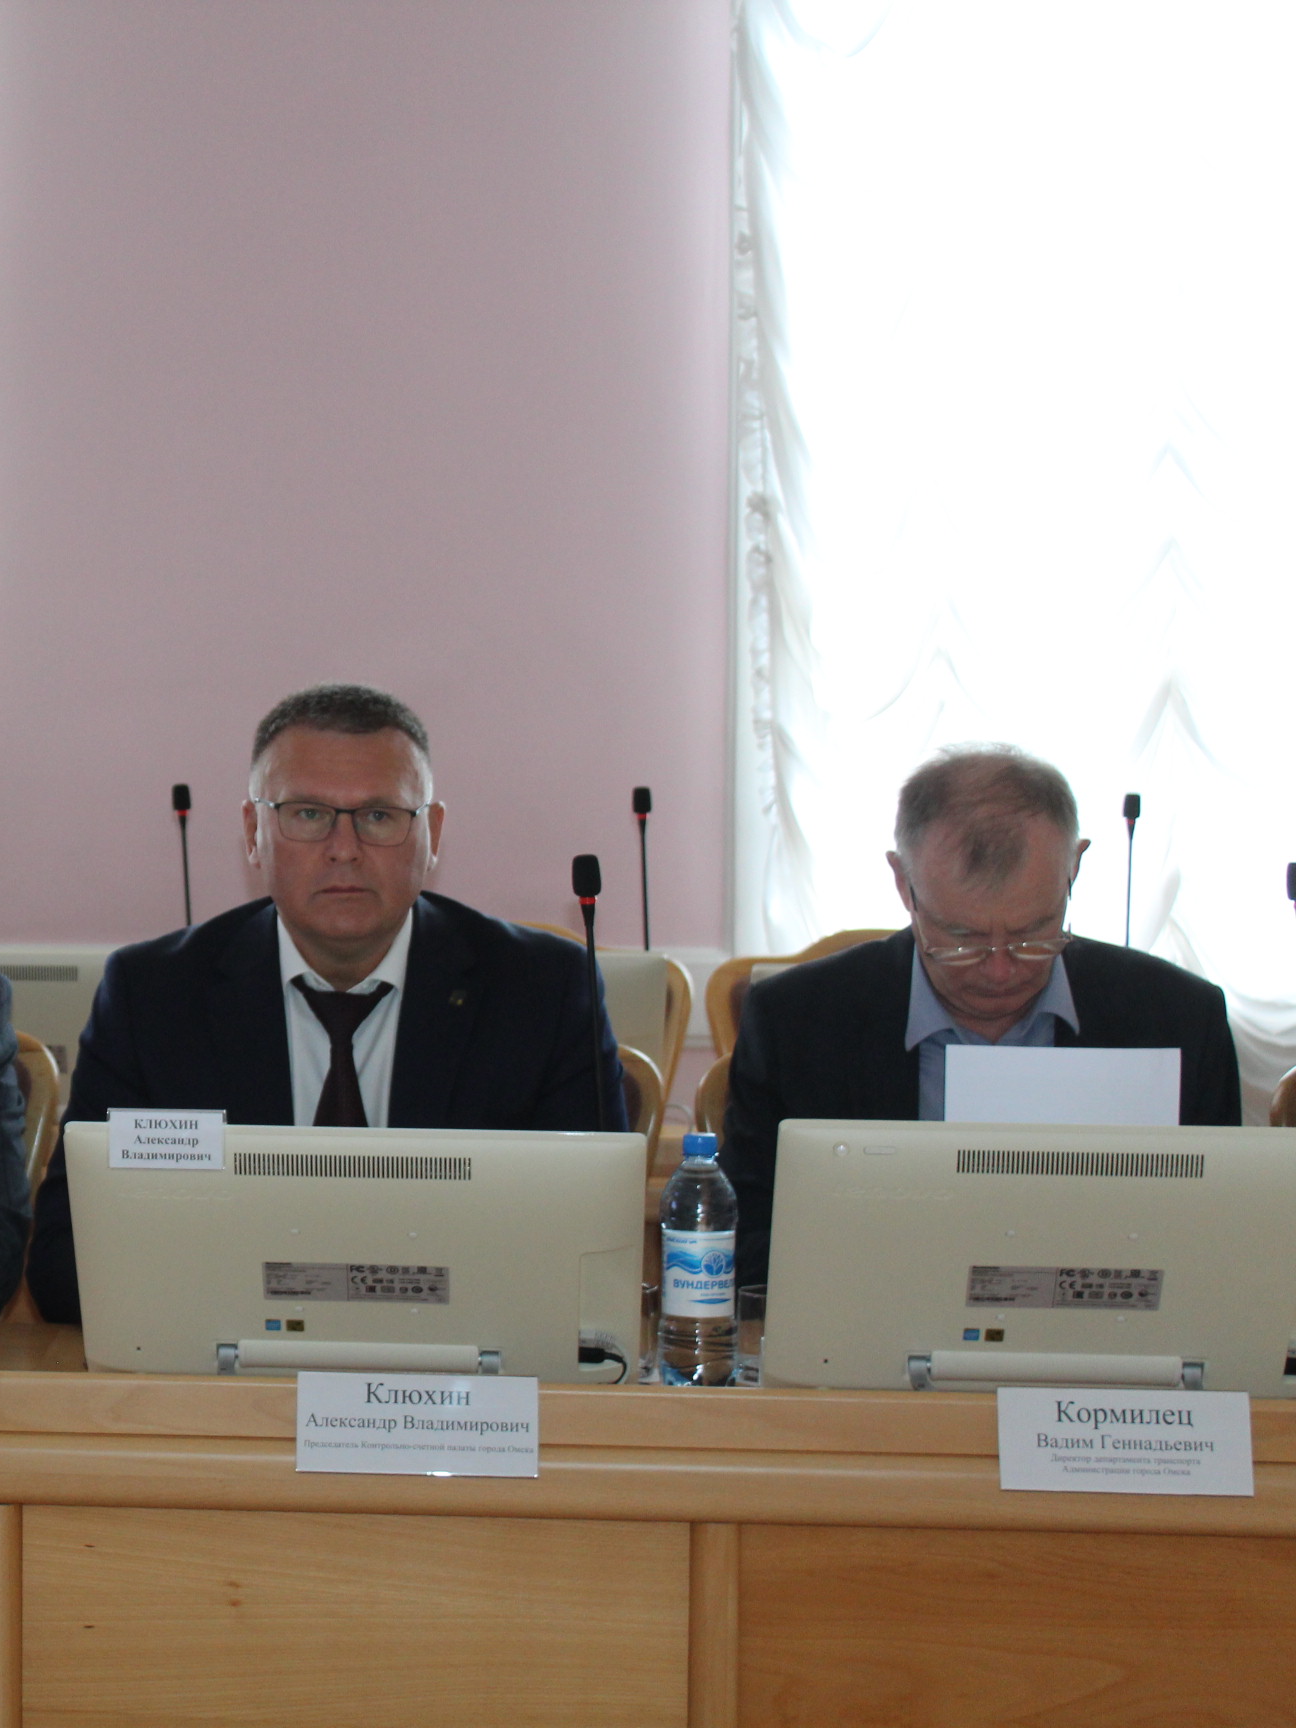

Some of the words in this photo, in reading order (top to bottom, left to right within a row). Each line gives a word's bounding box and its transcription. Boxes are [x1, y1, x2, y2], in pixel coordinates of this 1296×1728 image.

[134, 1119, 198, 1130] КЛЮХИН
[134, 1135, 199, 1148] Александр
[121, 1149, 212, 1162] Владимирович
[365, 1382, 471, 1406] Клюхин
[1055, 1401, 1194, 1429] Кормилец
[305, 1413, 397, 1433] Александр
[403, 1415, 531, 1435] Владимирович
[304, 1439, 359, 1449] Председатель
[478, 1445, 505, 1453] города
[507, 1445, 534, 1453] Омска
[1036, 1433, 1094, 1449] Вадим
[1100, 1434, 1215, 1452] Геннадьевич
[1132, 1468, 1161, 1476] города
[1163, 1467, 1192, 1476] Омска
